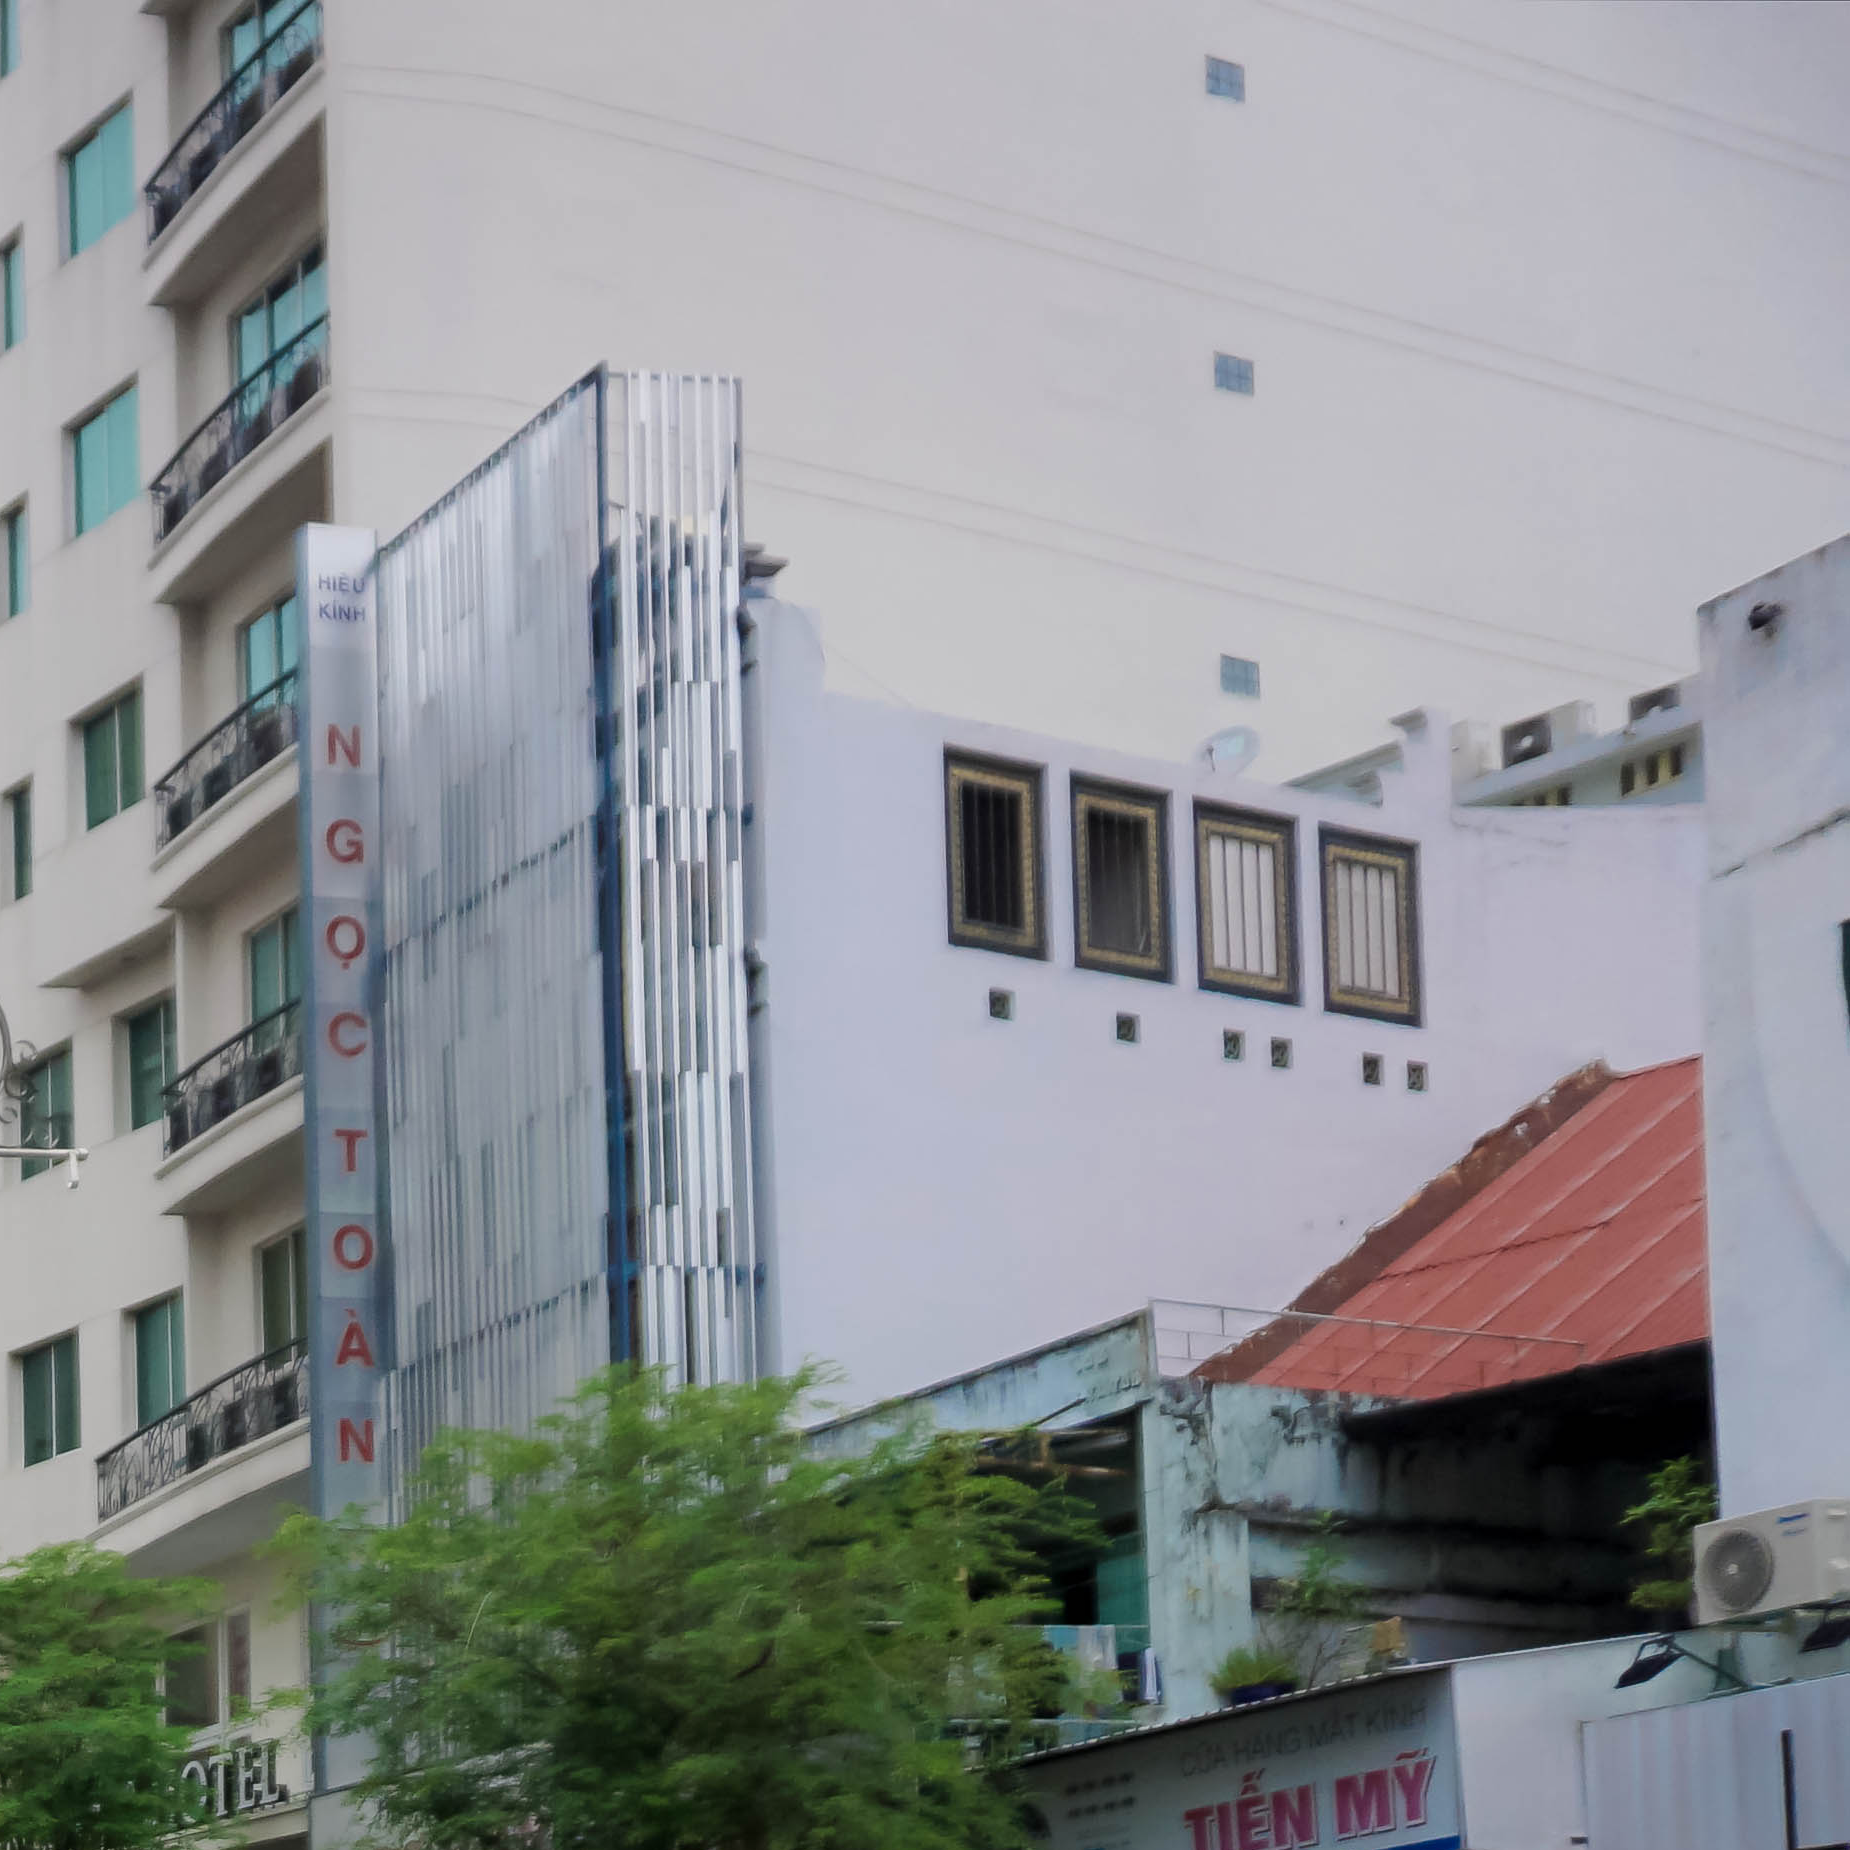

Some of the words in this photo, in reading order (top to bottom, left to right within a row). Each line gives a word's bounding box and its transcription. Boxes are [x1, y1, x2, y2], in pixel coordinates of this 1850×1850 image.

[323, 722, 367, 1059] NGỌC
[332, 1127, 376, 1463] TOÀN
[1334, 1747, 1437, 1842] MỸ
